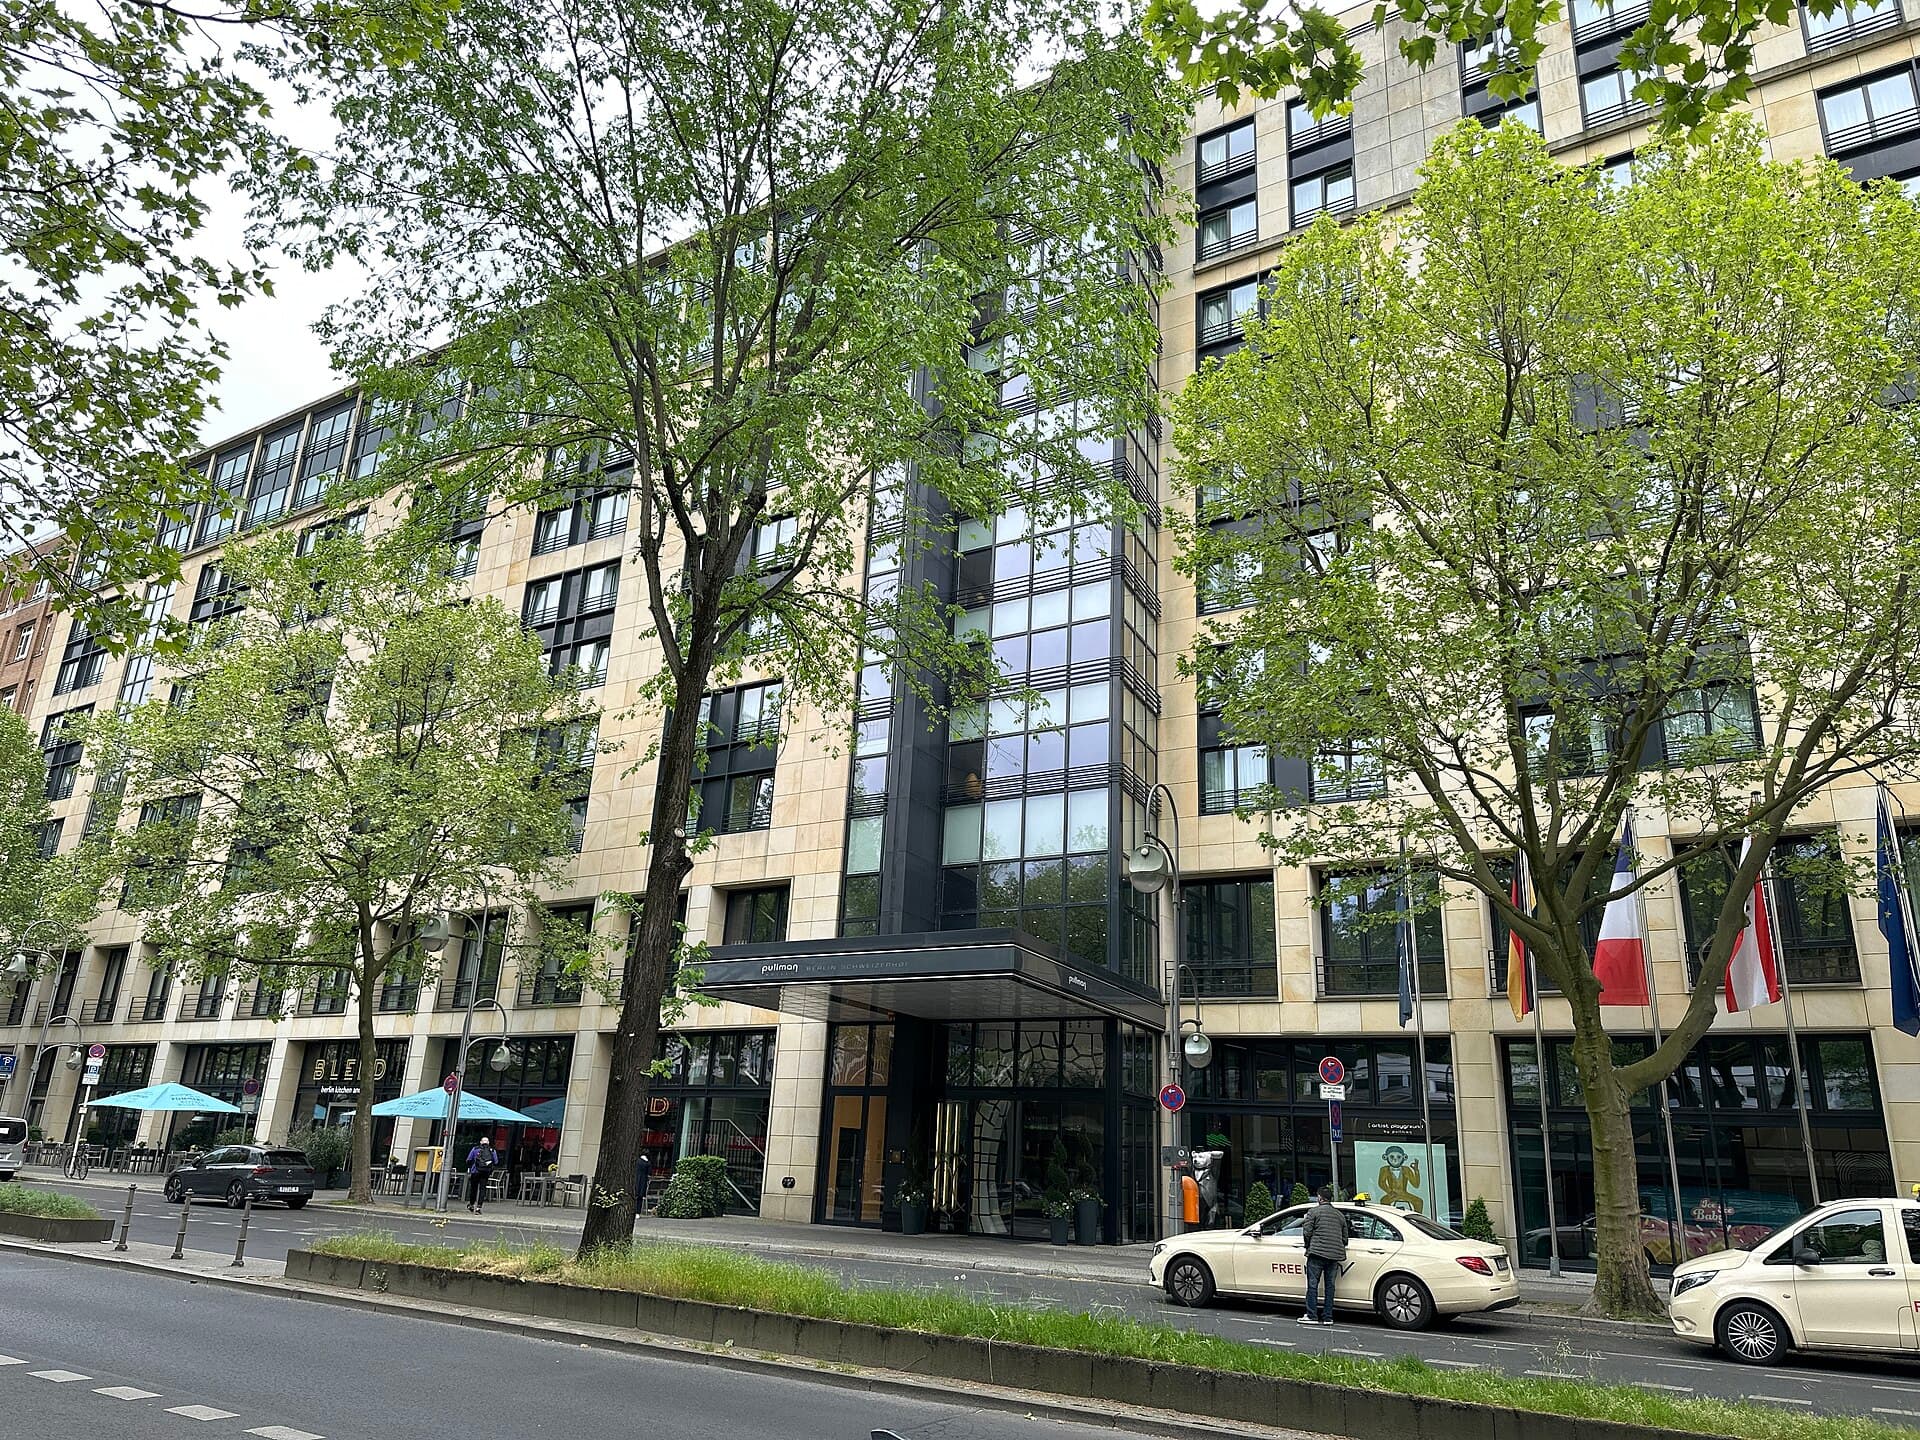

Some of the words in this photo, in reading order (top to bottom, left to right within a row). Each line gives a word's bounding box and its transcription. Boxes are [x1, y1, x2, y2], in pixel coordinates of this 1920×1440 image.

[761, 963, 799, 975] pullman
[313, 1058, 387, 1081] BLED
[320, 1085, 335, 1094] berlin
[334, 1085, 353, 1094] kitchen
[1271, 1263, 1302, 1275] FREE
